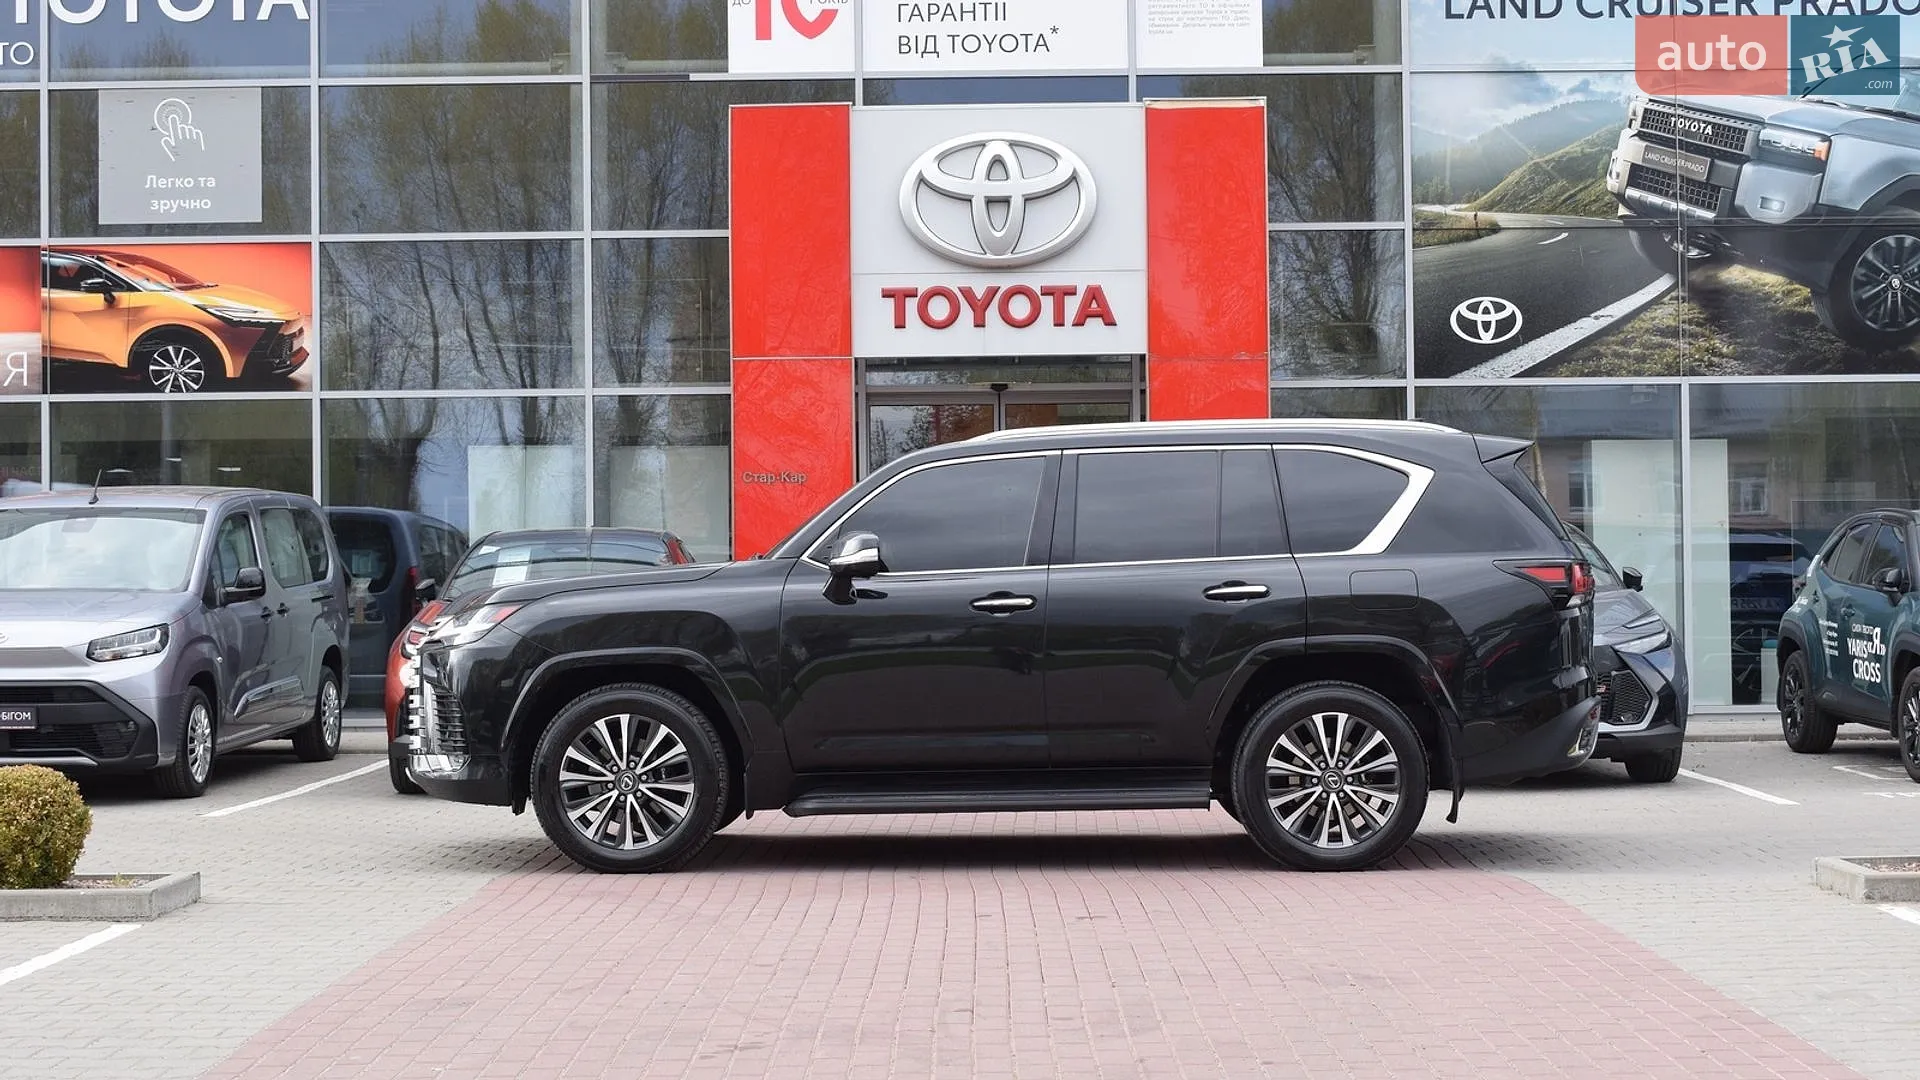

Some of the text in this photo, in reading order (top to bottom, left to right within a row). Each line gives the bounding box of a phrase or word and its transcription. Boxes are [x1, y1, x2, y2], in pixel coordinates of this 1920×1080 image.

[898, 35, 939, 58] ВІД
[1671, 117, 1713, 135] TOYOTA
[145, 175, 216, 189] Легко та
[150, 199, 212, 213] зручно
[881, 284, 1118, 330] TOYOTA
[742, 471, 807, 485] Стар-Кар
[1846, 637, 1868, 659] YARIS
[1852, 658, 1881, 683] CROSS
